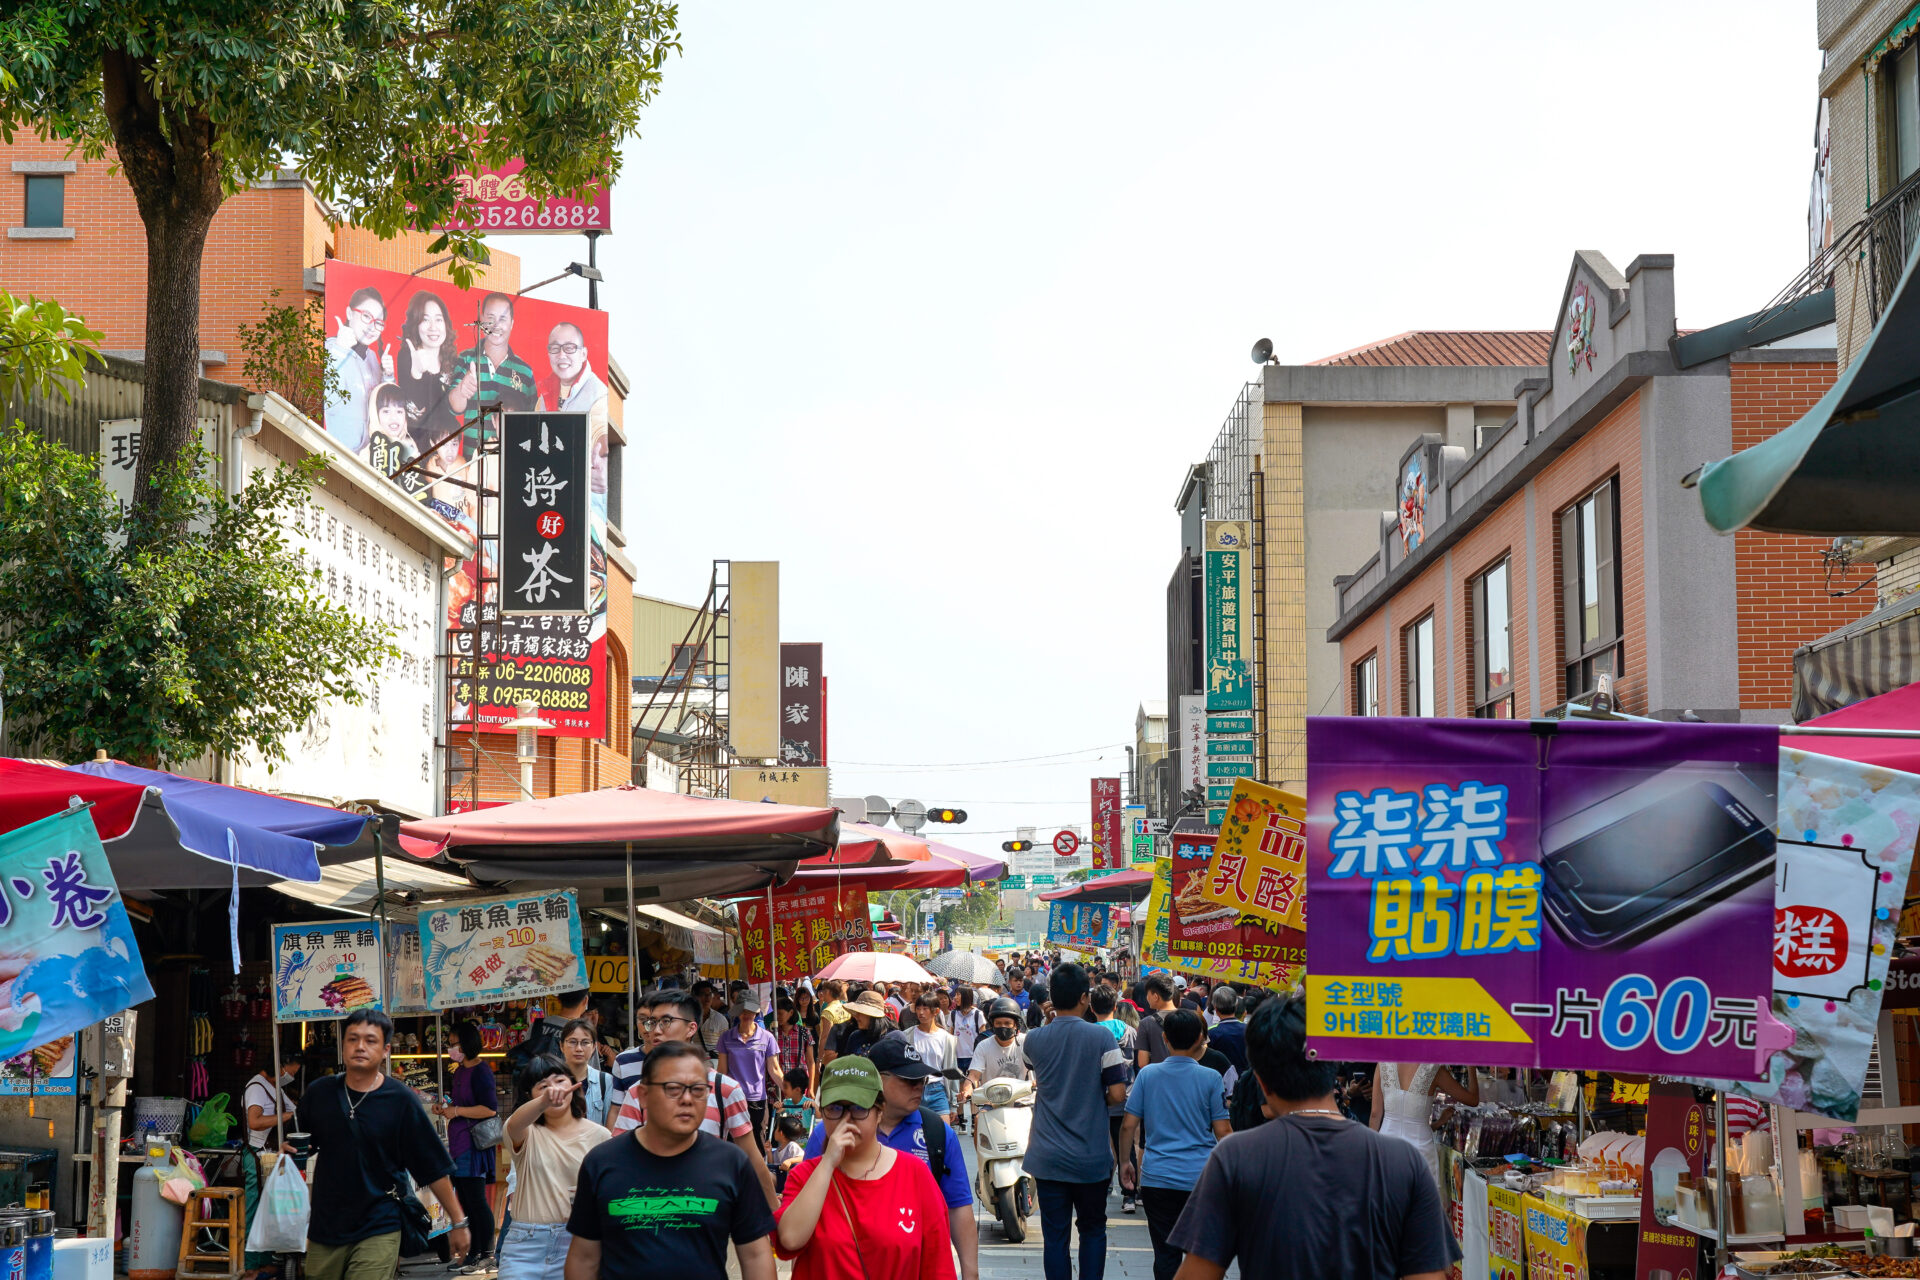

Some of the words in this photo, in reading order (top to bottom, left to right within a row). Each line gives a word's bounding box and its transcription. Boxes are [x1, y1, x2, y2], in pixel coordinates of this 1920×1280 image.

[514, 421, 573, 603] 小將好茶
[1221, 553, 1237, 692] 安平旅遊資訊中心
[495, 662, 591, 686] 06-2206088
[493, 686, 588, 709] 0955268882
[1330, 783, 1505, 876] 柒柒
[1222, 852, 1307, 924] 乳酪
[460, 896, 568, 932] 旗魚黑輪
[1370, 867, 1543, 960] 貼膜
[282, 929, 375, 951] 旗魚黑輪
[1773, 910, 1836, 971] 糕
[468, 953, 506, 986] 現做
[1269, 962, 1292, 985] 茶
[1323, 982, 1403, 1007] 全型號
[1323, 1011, 1491, 1037] 9H鋼化玻璃貼
[1686, 1236, 1695, 1248] 50
